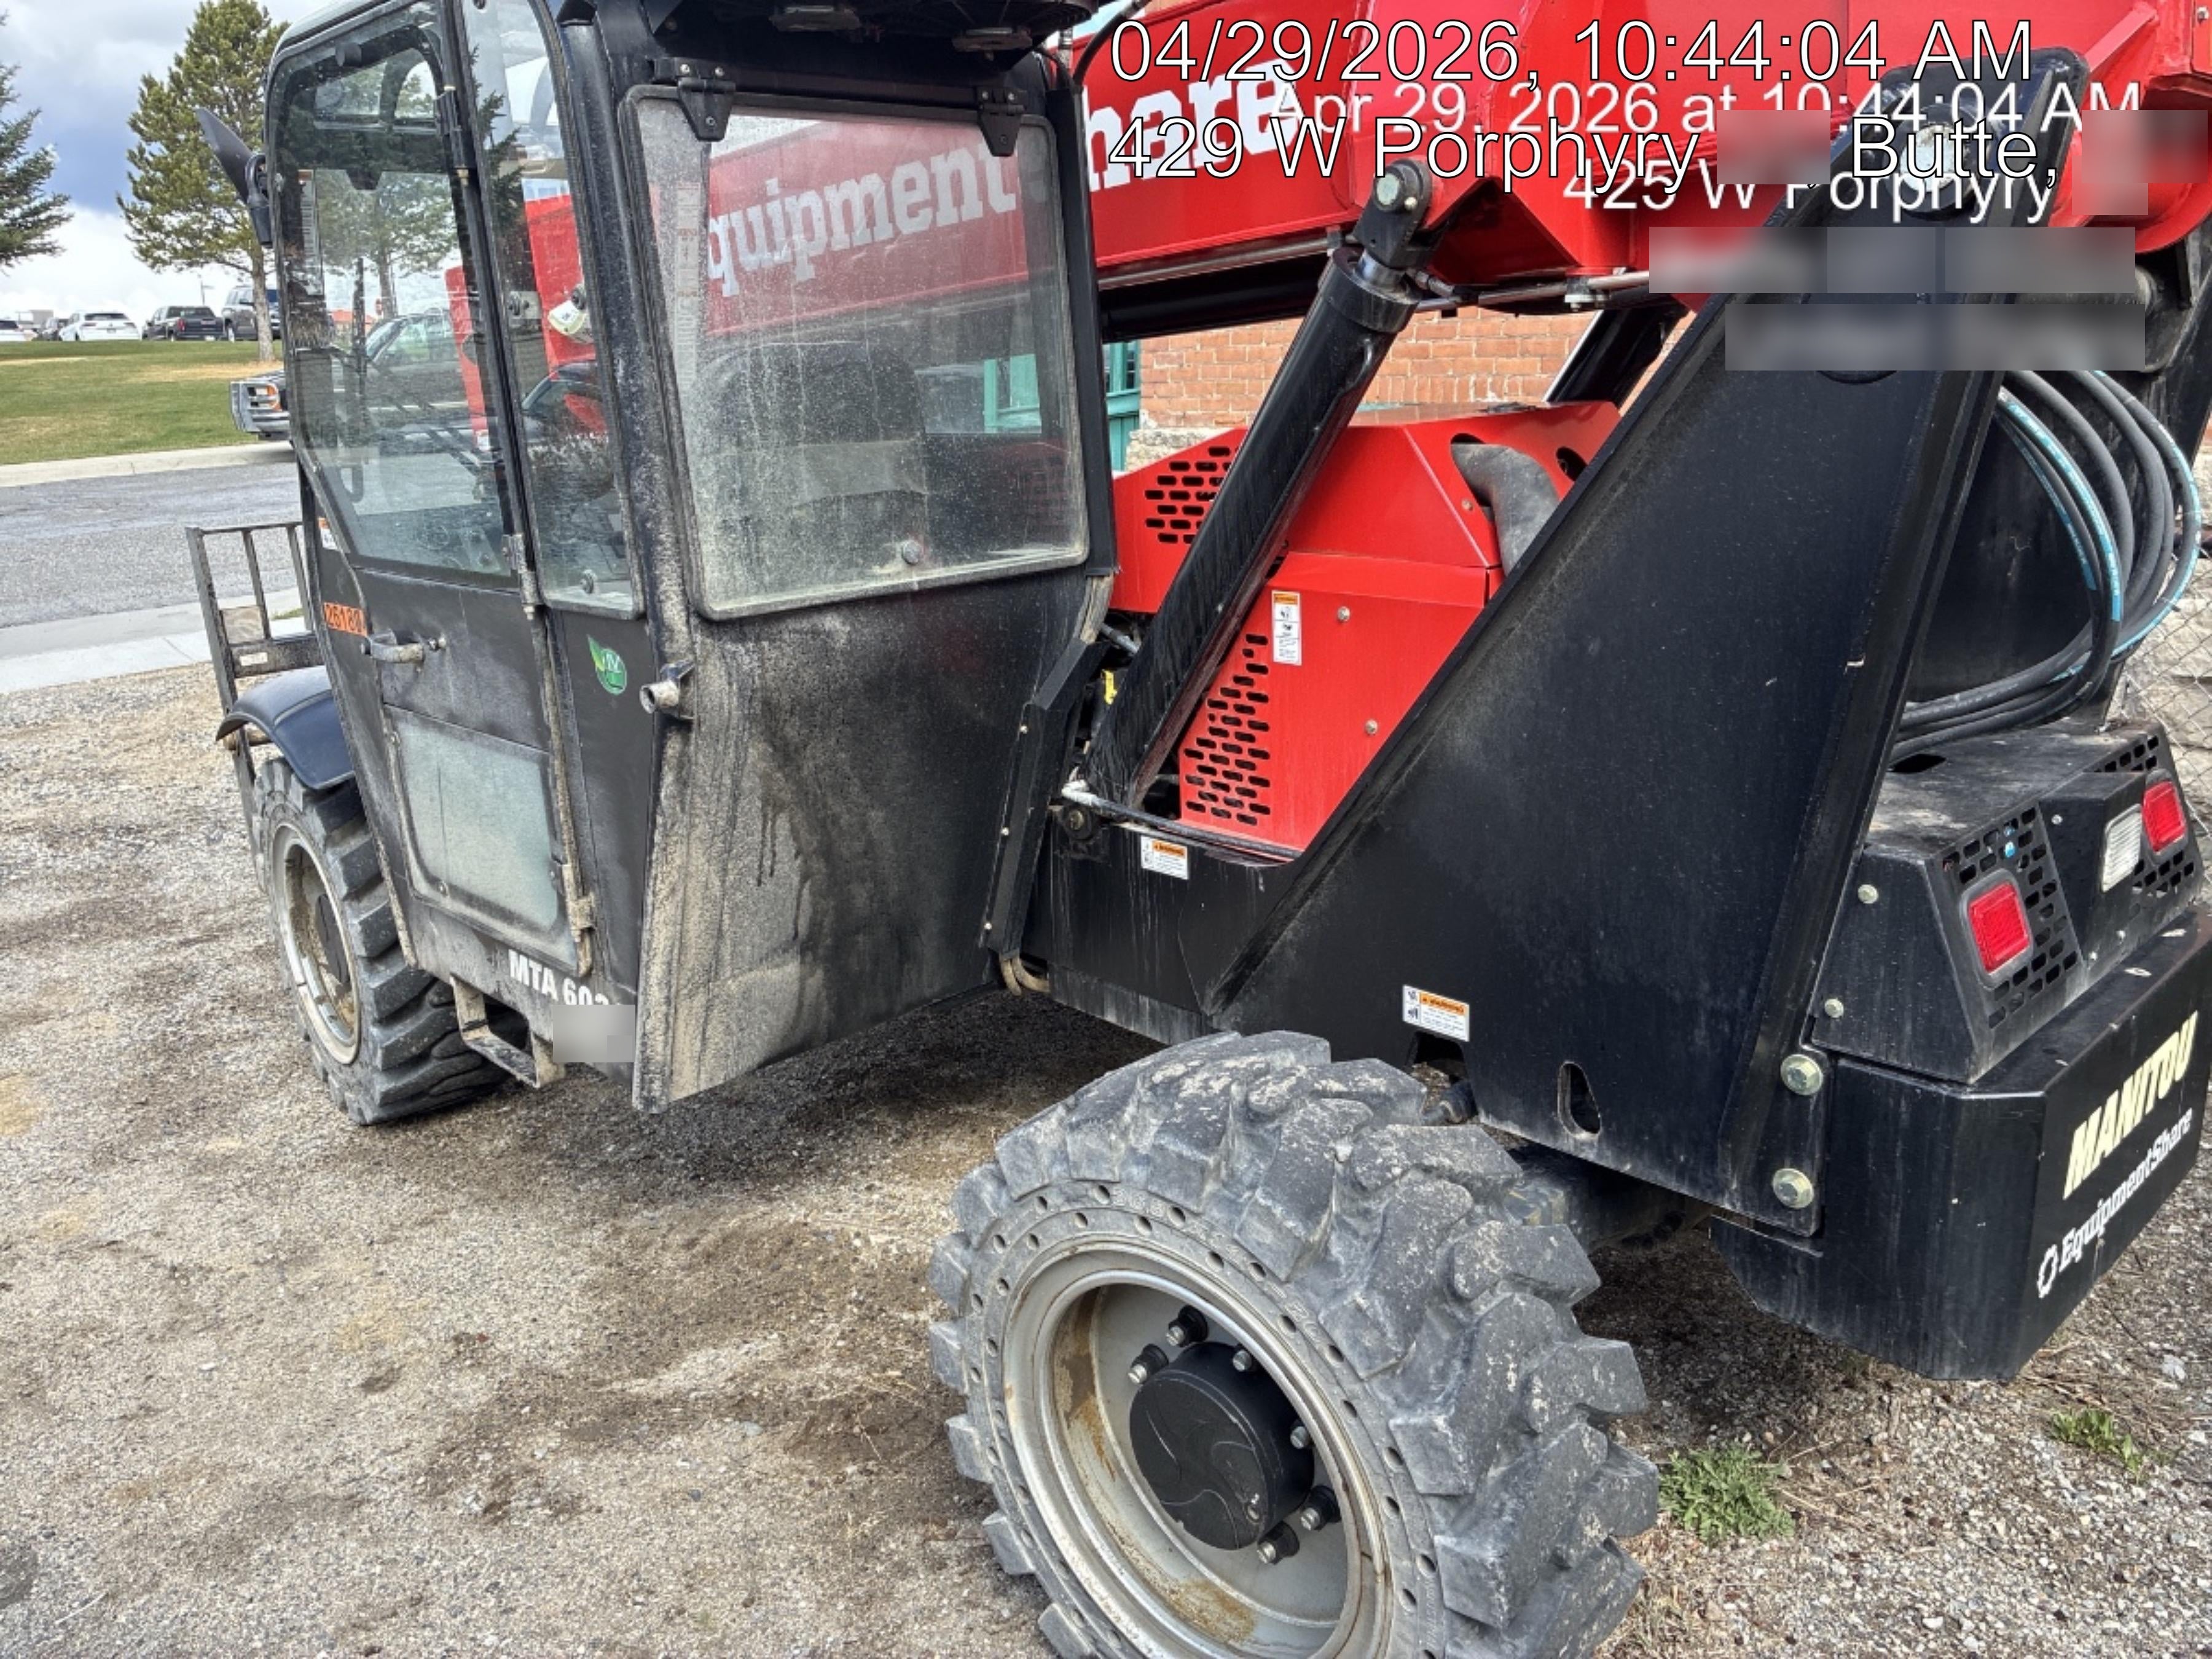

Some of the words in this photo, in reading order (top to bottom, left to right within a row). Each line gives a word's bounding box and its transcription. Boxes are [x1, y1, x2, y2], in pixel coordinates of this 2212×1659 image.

[1083, 58, 1300, 192] hare
[708, 144, 1017, 297] quipment
[508, 949, 559, 1002] MTA
[2062, 1010, 2198, 1200] MANITOU
[2058, 1107, 2193, 1274] EquipmentShare
